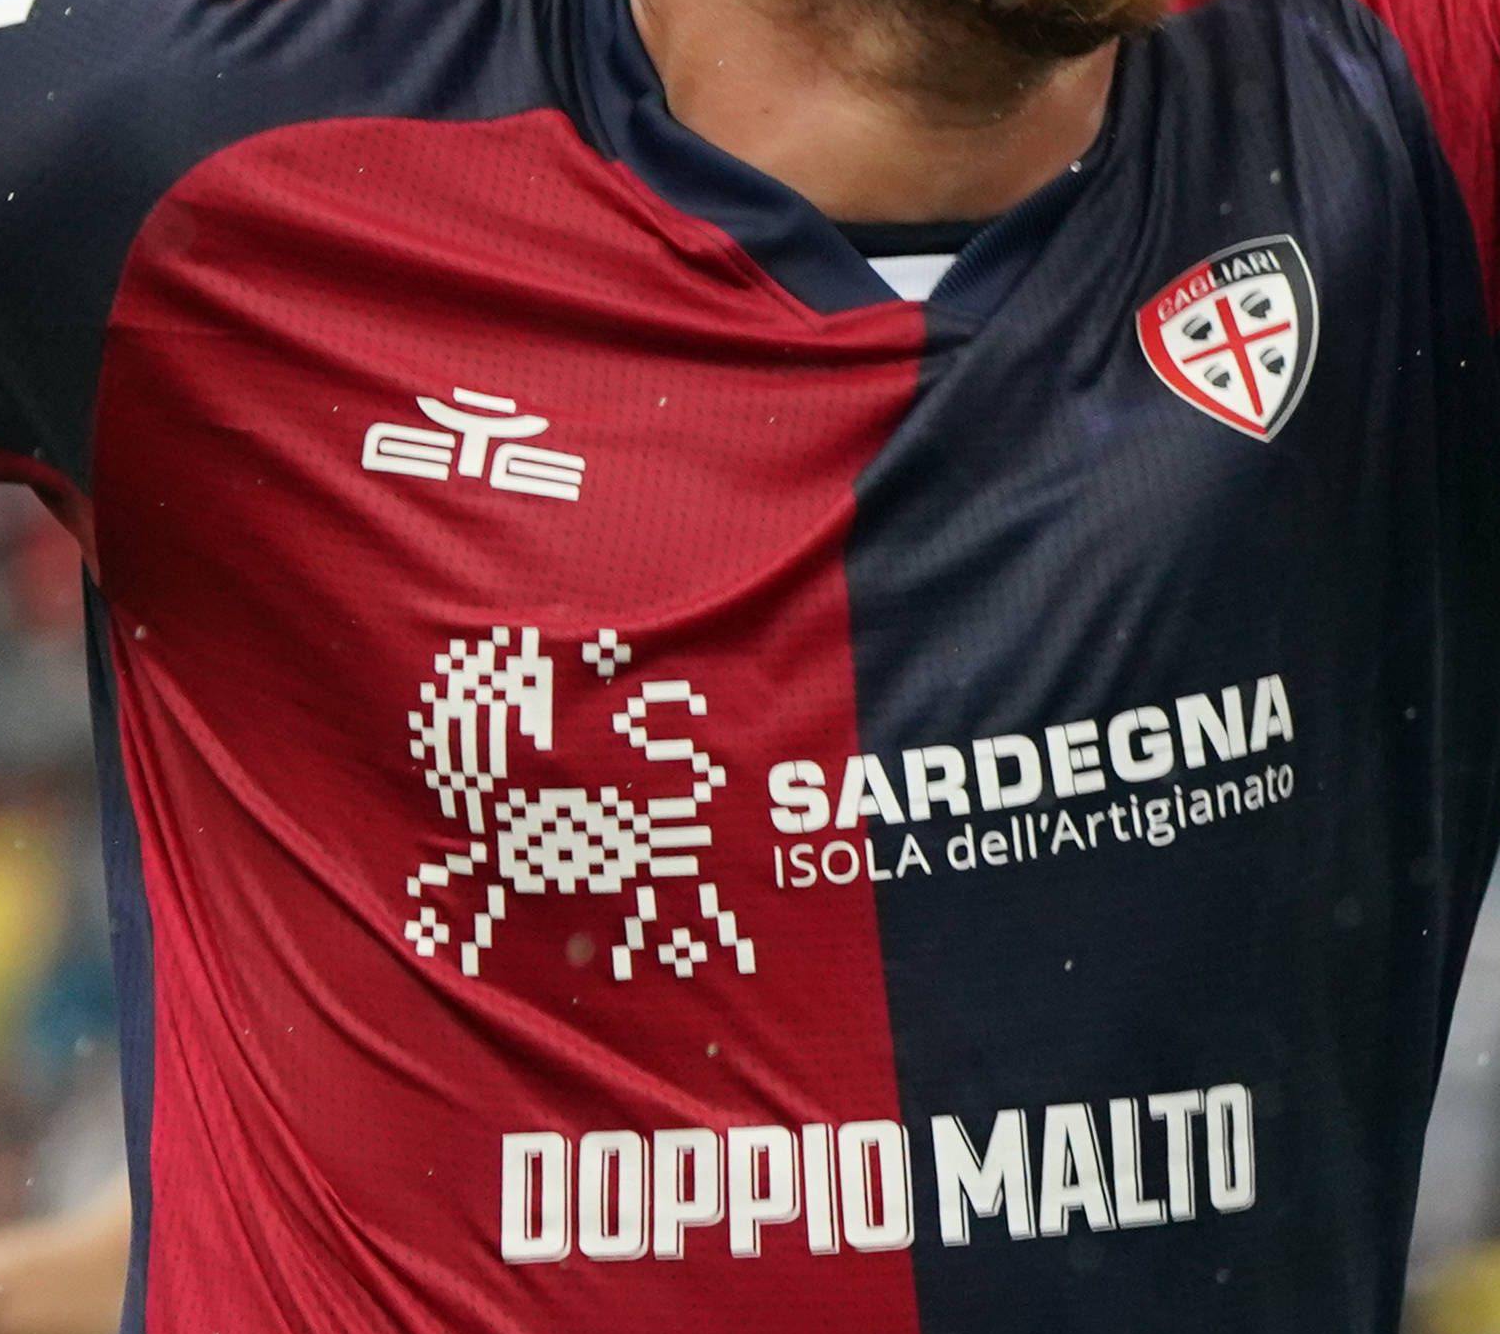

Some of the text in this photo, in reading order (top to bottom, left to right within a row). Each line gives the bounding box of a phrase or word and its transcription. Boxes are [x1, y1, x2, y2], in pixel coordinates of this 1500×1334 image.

[1157, 248, 1282, 323] CAGLIARI
[767, 673, 1295, 834] SARDEGNA
[772, 762, 1295, 889] ISOLA dell'Artigianato
[501, 1083, 1257, 1265] DOPPIO MALTO
